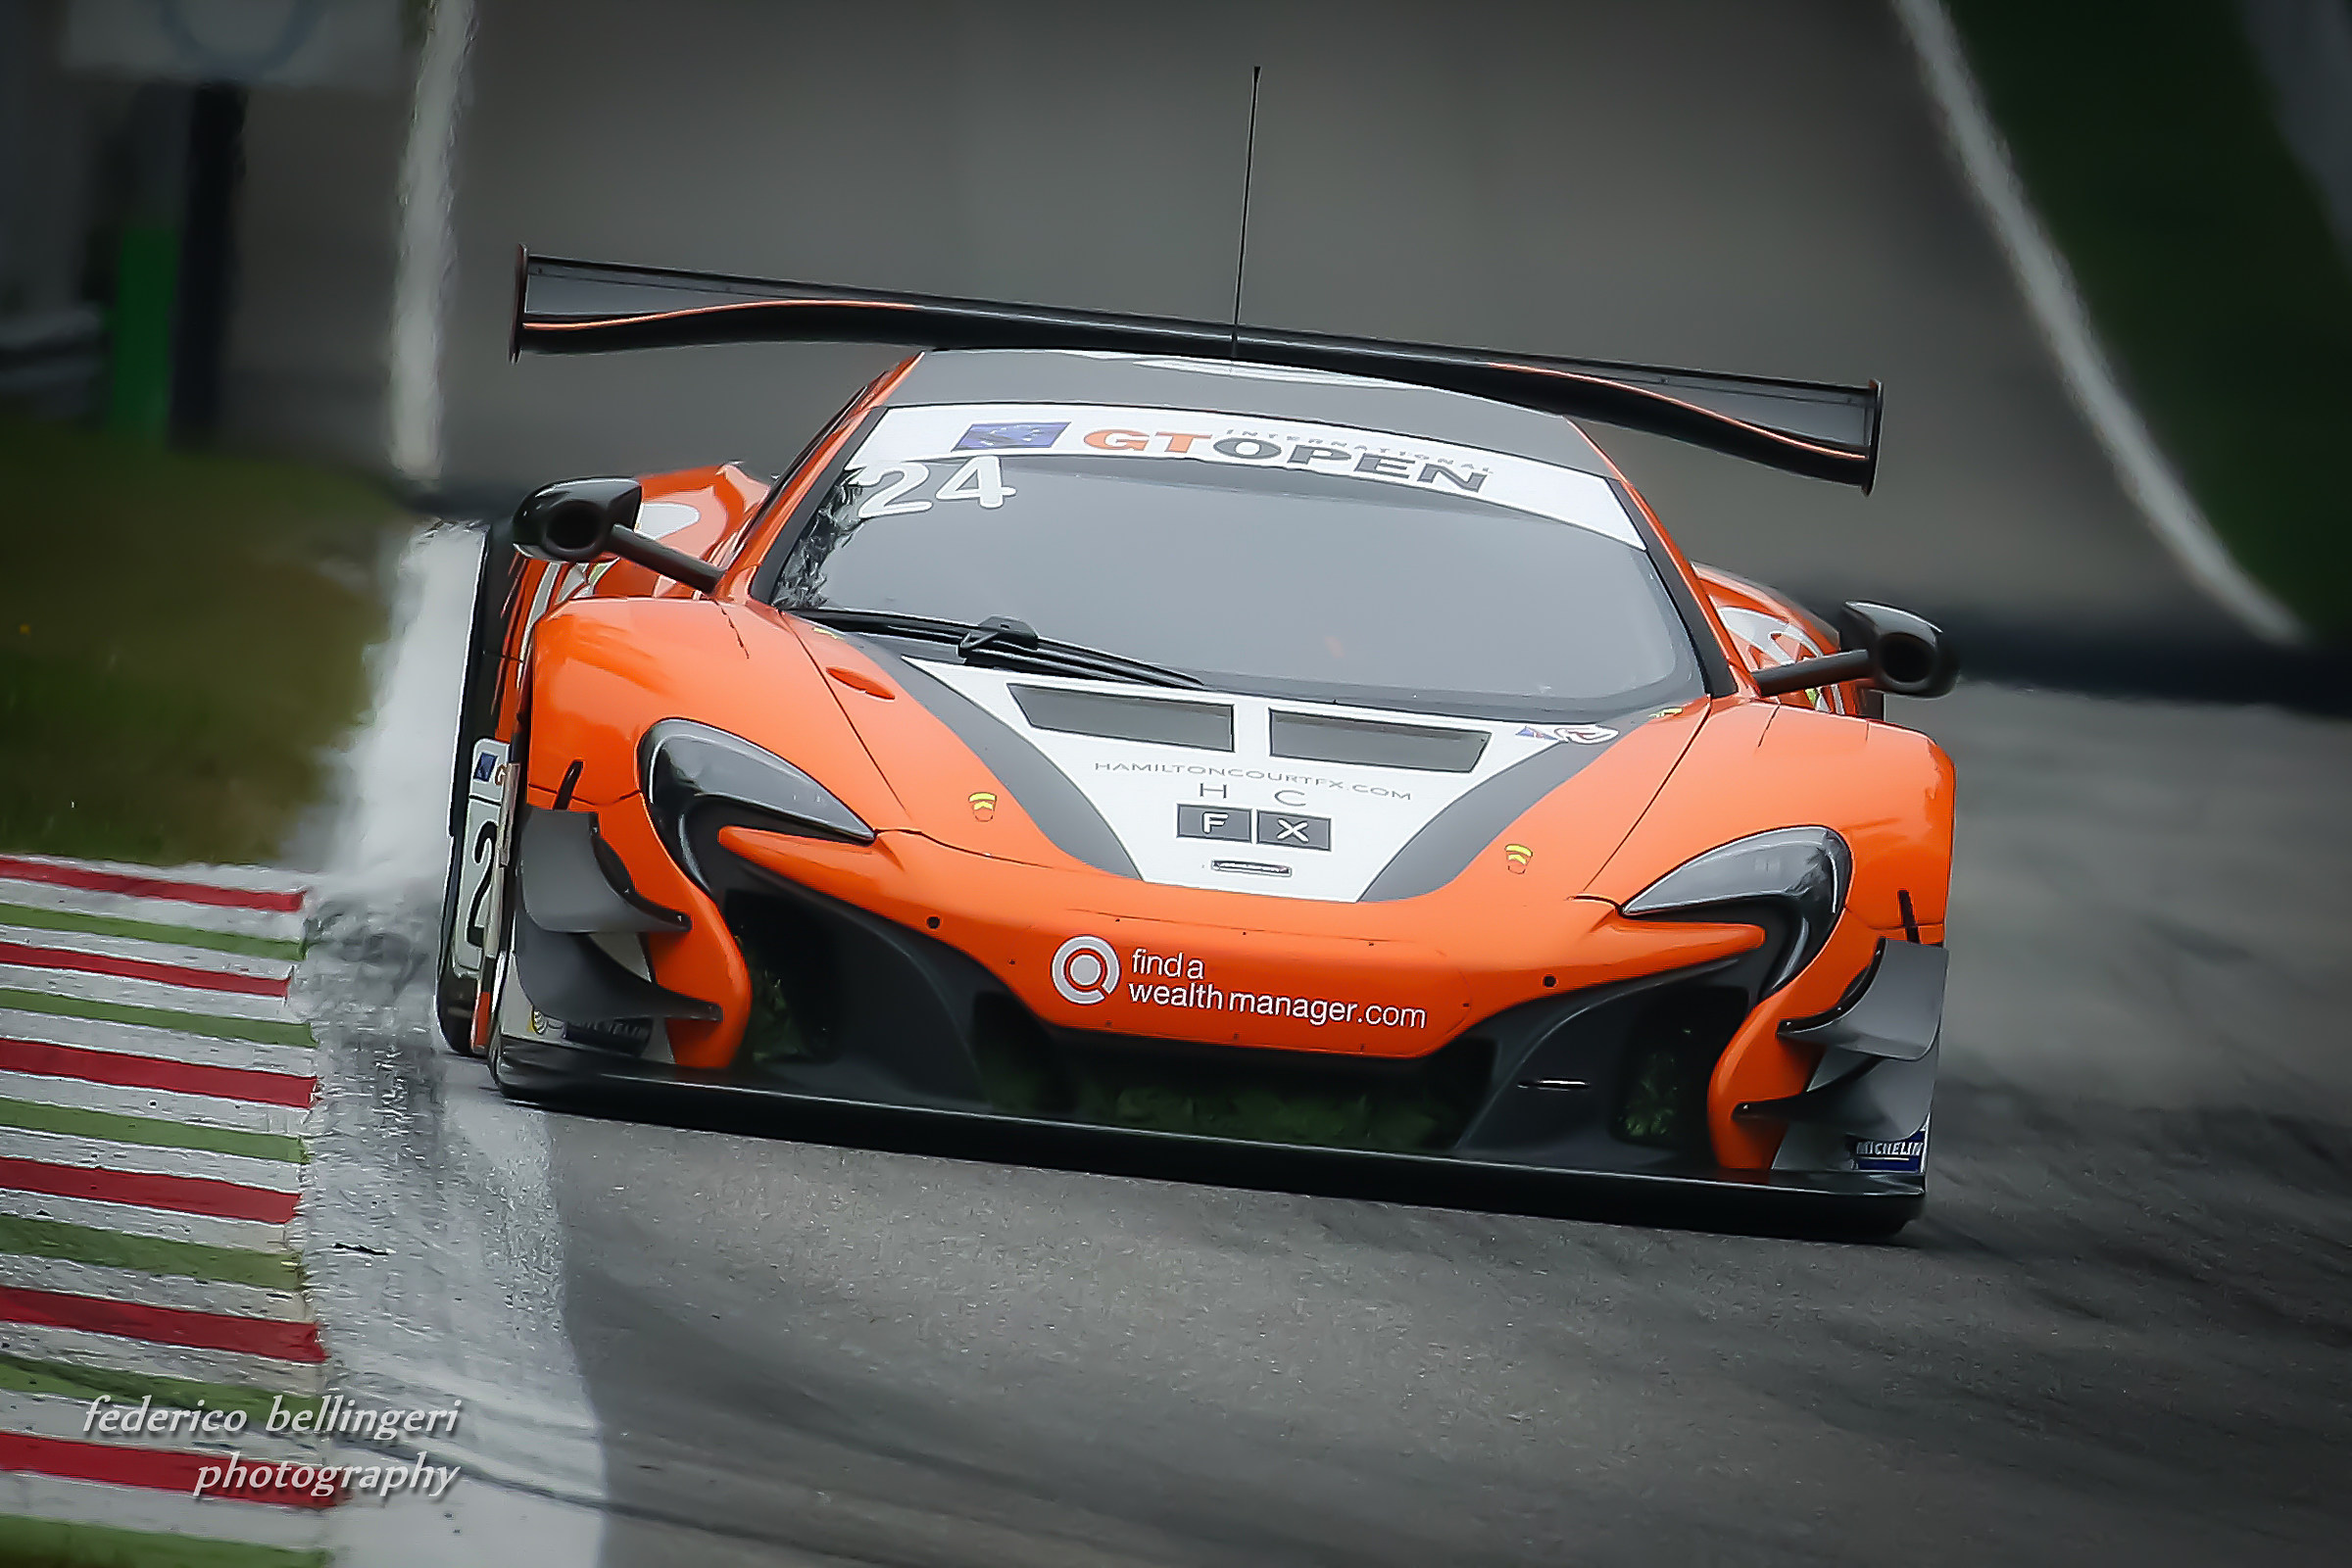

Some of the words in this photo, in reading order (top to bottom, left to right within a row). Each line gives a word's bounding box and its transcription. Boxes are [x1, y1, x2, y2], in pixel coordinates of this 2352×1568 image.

[851, 455, 1017, 518] 24
[1094, 761, 1412, 802] HAMILTONCOURTFX.COM
[1856, 1142, 1923, 1156] MICHELIN
